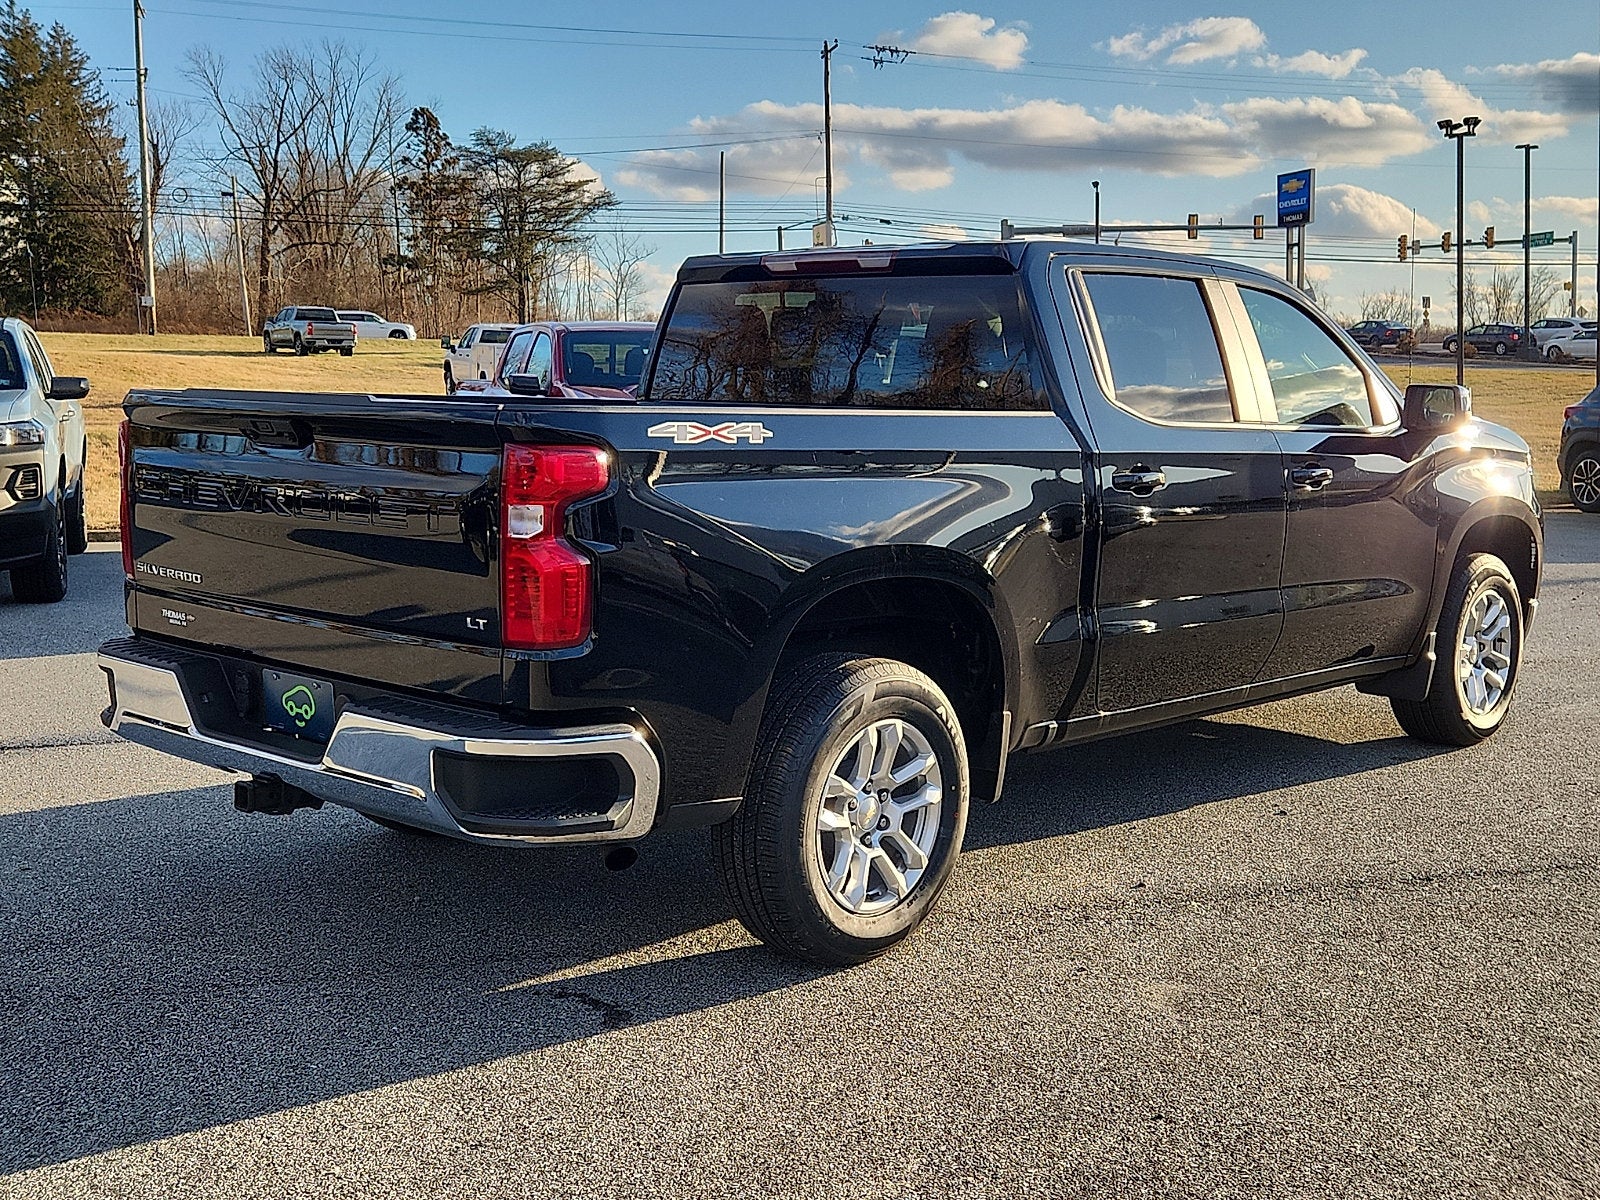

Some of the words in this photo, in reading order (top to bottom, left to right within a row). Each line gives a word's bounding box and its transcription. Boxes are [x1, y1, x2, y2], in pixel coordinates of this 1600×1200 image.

[1279, 197, 1307, 209] CHEVROLET
[1283, 213, 1303, 222] THOMAS
[134, 469, 456, 532] CHEVROLET
[136, 562, 202, 584] SILVERADO
[162, 609, 186, 620] THOMAS
[466, 617, 488, 630] LT
